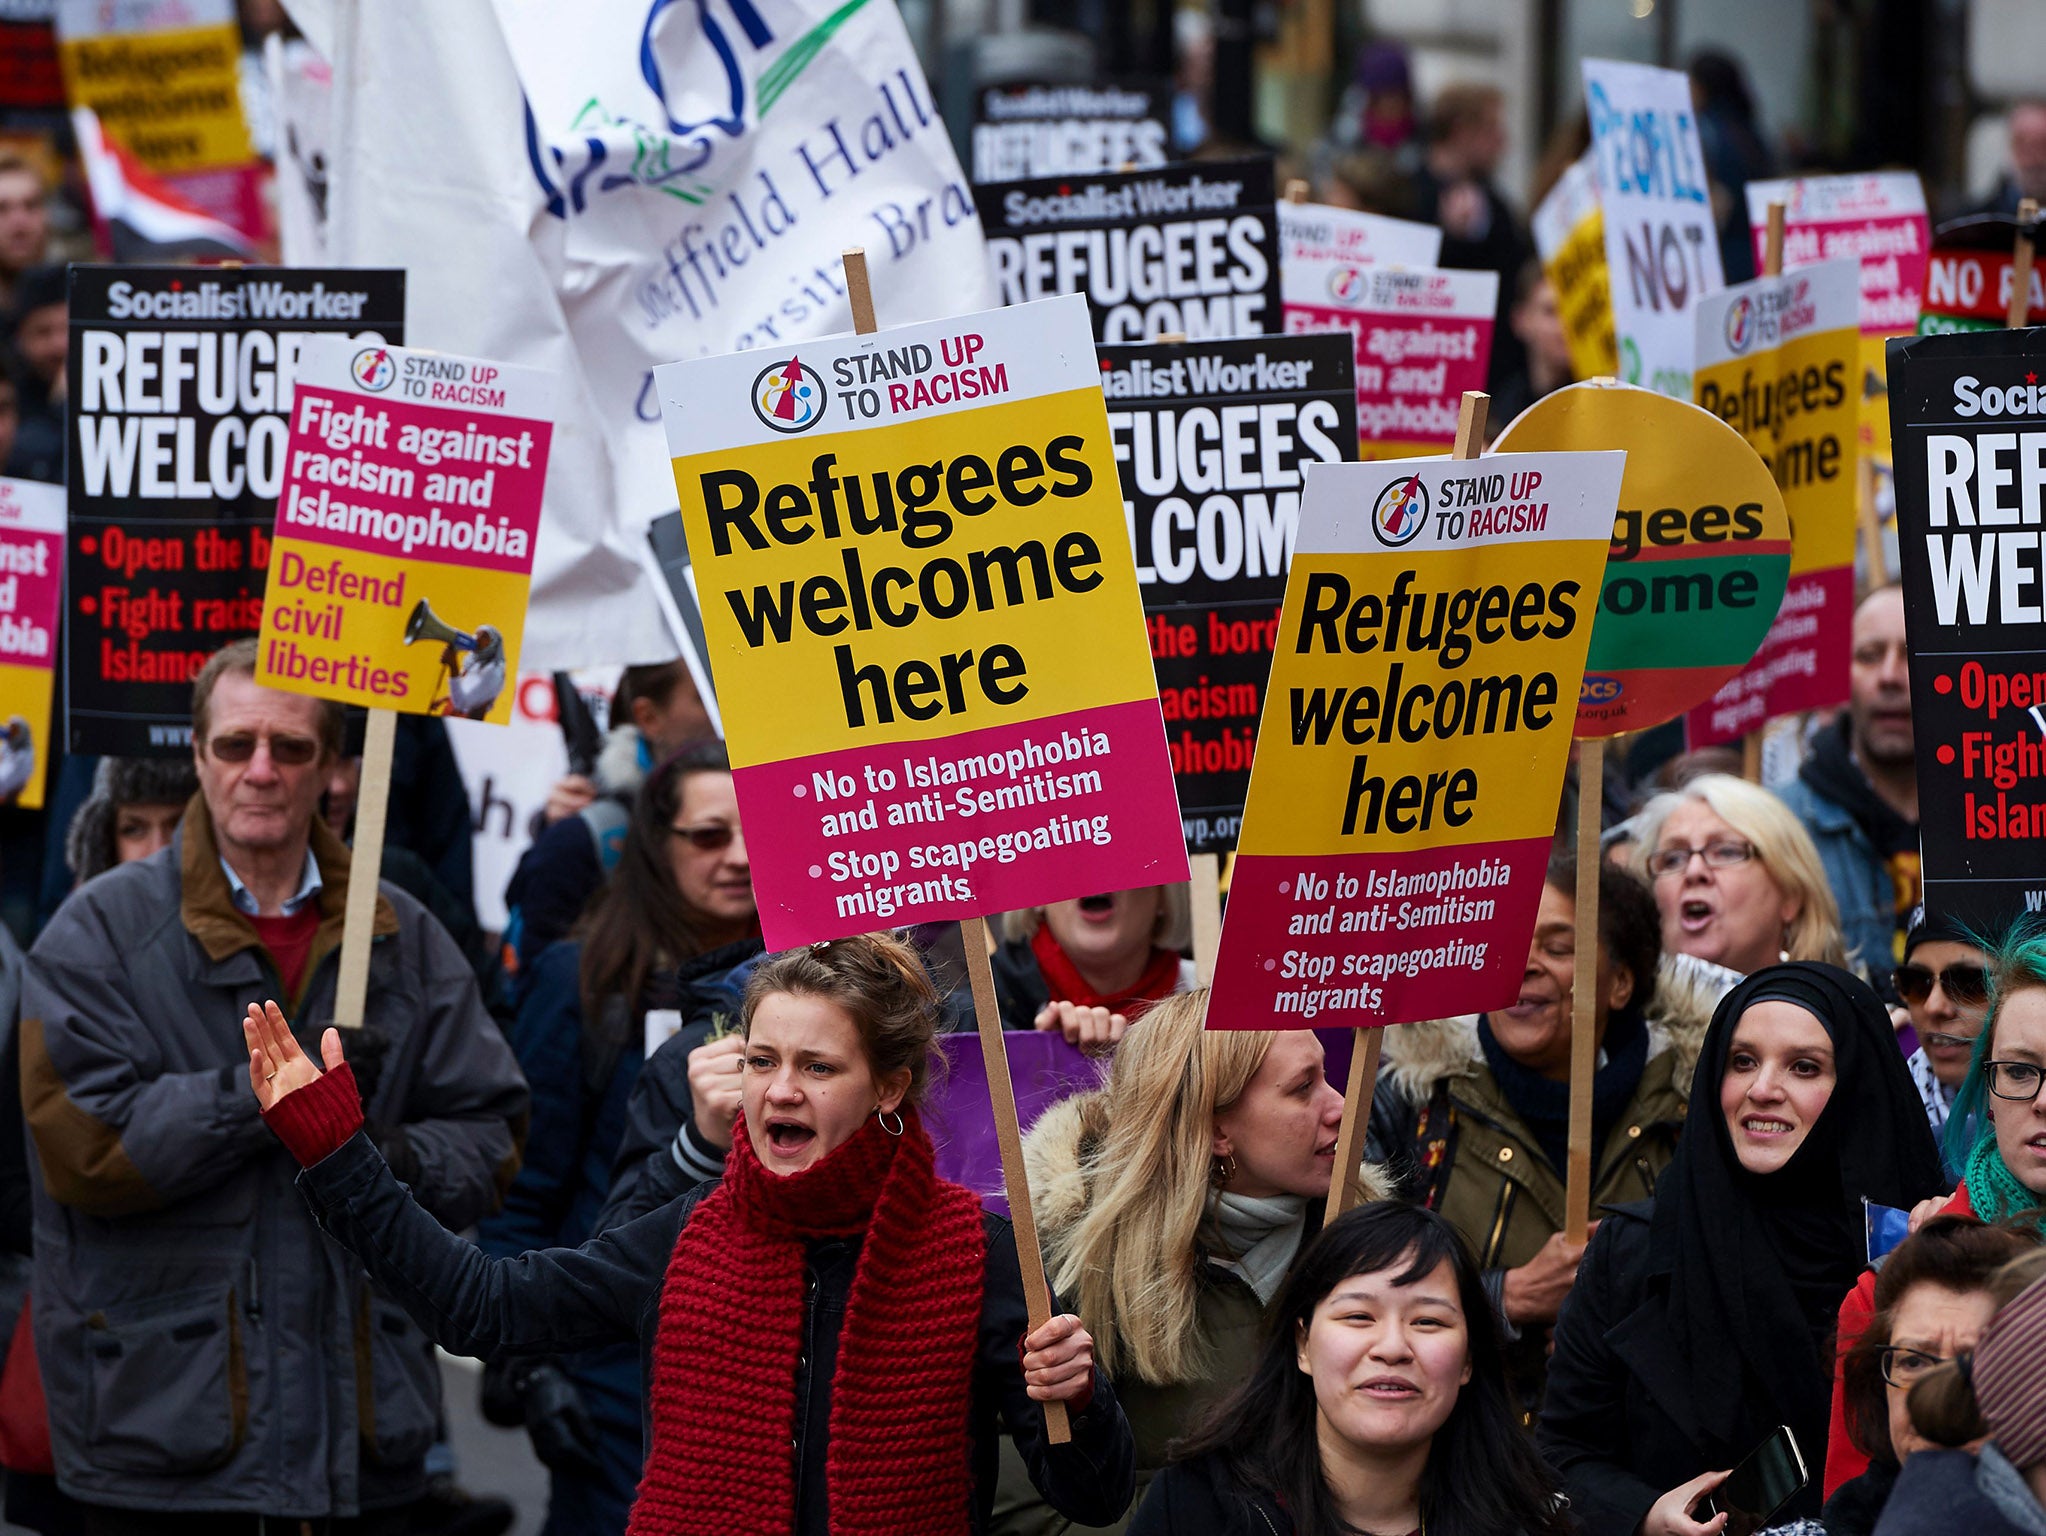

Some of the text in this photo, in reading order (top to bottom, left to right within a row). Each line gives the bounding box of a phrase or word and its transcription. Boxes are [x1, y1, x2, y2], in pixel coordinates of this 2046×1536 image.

[637, 170, 797, 330] ffield
[795, 69, 929, 198] Hall
[872, 182, 976, 263] Bra
[988, 215, 1268, 306] REFUGEES
[1623, 220, 1706, 313] NOT
[1927, 258, 1985, 309] NO
[404, 357, 498, 386] STAND UP
[832, 333, 985, 388] STAND UP
[1367, 322, 1477, 363] against
[401, 378, 506, 408] TO RACISM
[837, 363, 1010, 421] TO RACISM
[1100, 358, 1187, 399] ialist
[1388, 360, 1446, 396] and
[1952, 373, 2046, 417] Soci
[78, 414, 290, 499] WELCO
[298, 396, 534, 469] Fight against
[1107, 399, 1342, 497] FUGEES
[291, 449, 495, 509] racism and
[700, 435, 1094, 557] Refugees
[1438, 471, 1543, 509] STAND UP
[1926, 431, 2046, 527] REF
[285, 484, 529, 559] Islamophobia
[1123, 491, 1300, 584] LCOM
[1435, 502, 1549, 541] TO RACISM
[1608, 502, 1764, 562] gees
[0, 539, 48, 578] nst
[101, 525, 185, 580] Open
[195, 527, 243, 570] the
[279, 552, 406, 608] Defend
[1925, 530, 2046, 627] WE
[100, 586, 264, 639] Fight racis
[724, 532, 1105, 649] welcome
[1295, 569, 1582, 670] Refugees
[0, 613, 49, 657] bia
[272, 599, 344, 641] civil
[1207, 608, 1282, 655] bord
[266, 639, 410, 697] liberties
[833, 643, 1030, 729] here
[1160, 674, 1258, 722] acism
[1289, 661, 1559, 746] welcome
[812, 728, 1111, 803] No to Islamophobia
[820, 769, 1103, 838] and anti-Semitism
[1340, 754, 1478, 836] here
[827, 813, 1112, 882] Stop scapegoating
[835, 874, 971, 918] migrants
[1294, 858, 1512, 902] No to Islamophobia
[1288, 896, 1496, 935] and anti-Semitism
[1279, 938, 1489, 984] Stop scapegoating
[1273, 982, 1384, 1018] migrants
